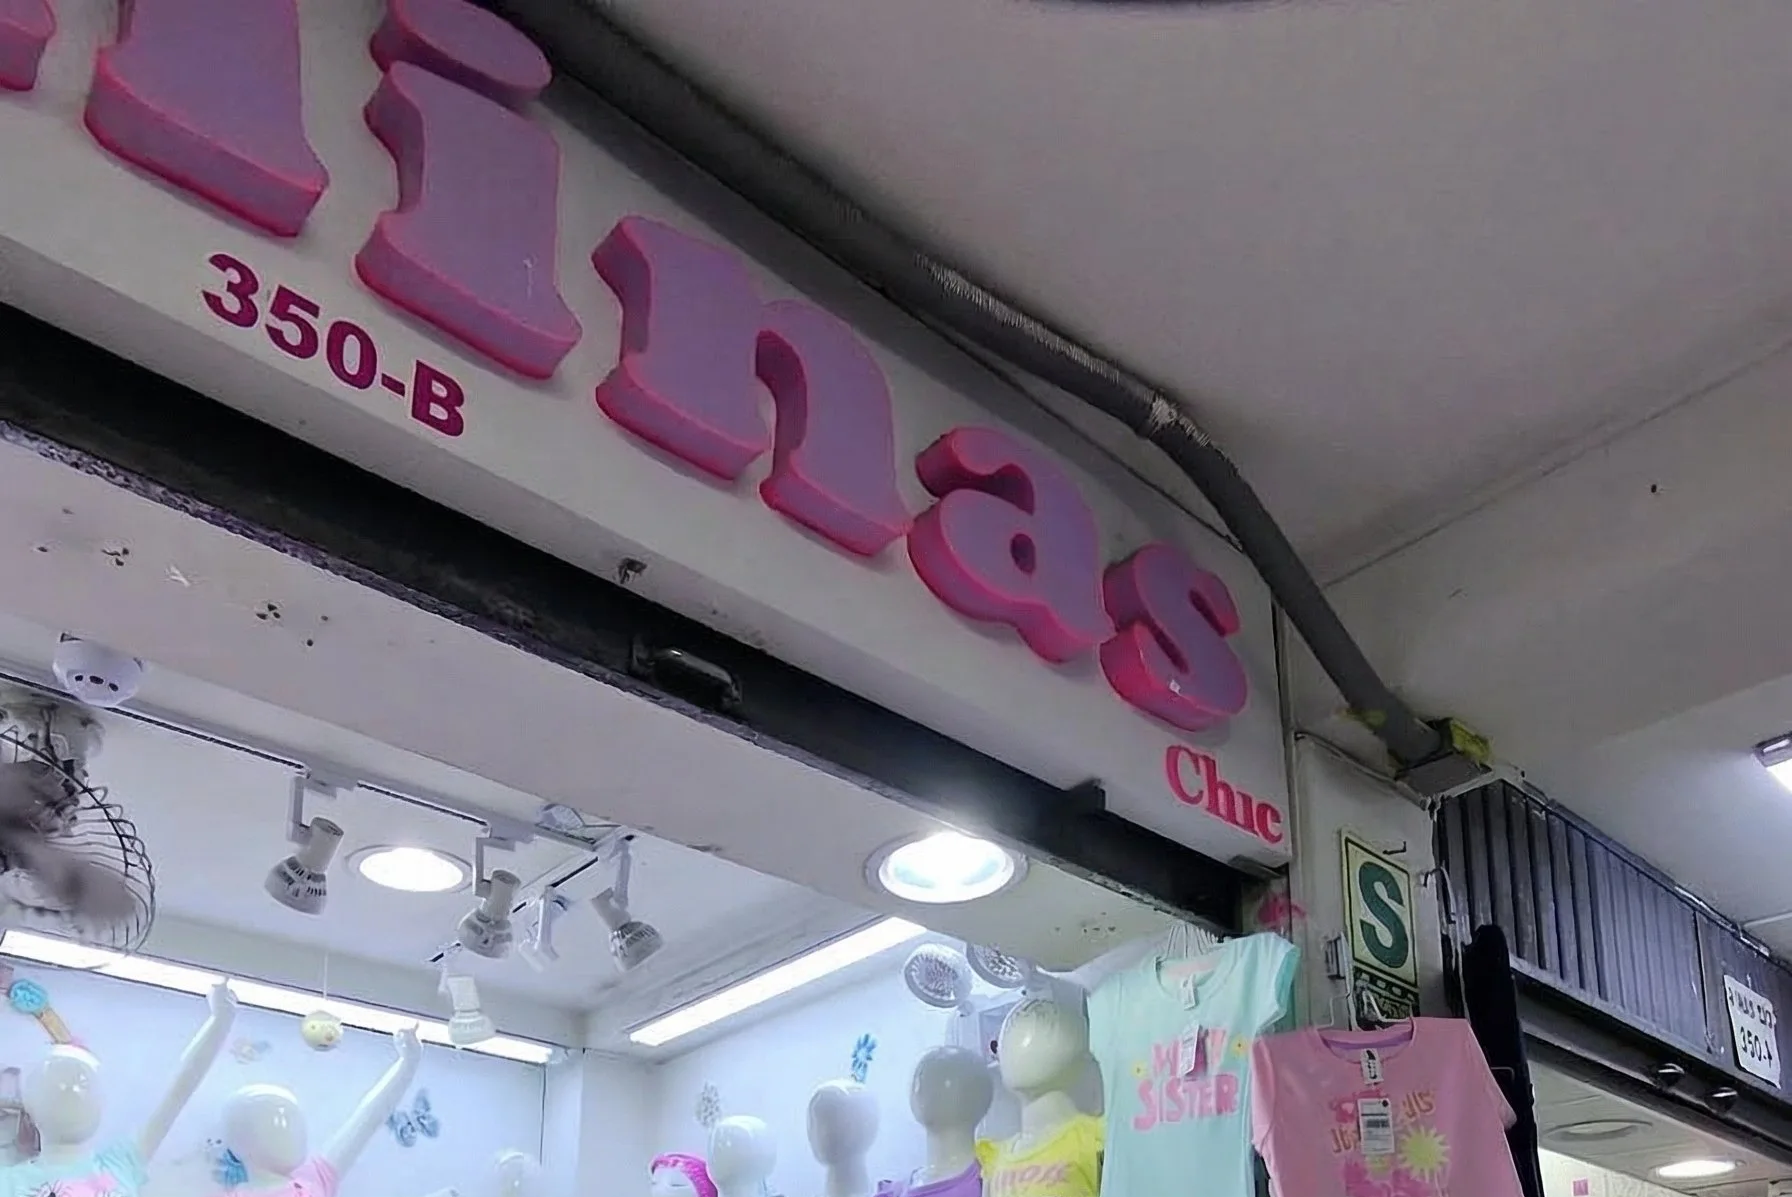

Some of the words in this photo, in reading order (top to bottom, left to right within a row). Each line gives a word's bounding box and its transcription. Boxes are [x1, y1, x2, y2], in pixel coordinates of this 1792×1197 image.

[200, 252, 466, 438] 350-B
[1164, 744, 1284, 844] Chic
[1359, 861, 1409, 969] S
[1132, 1073, 1240, 1132] SISTER
